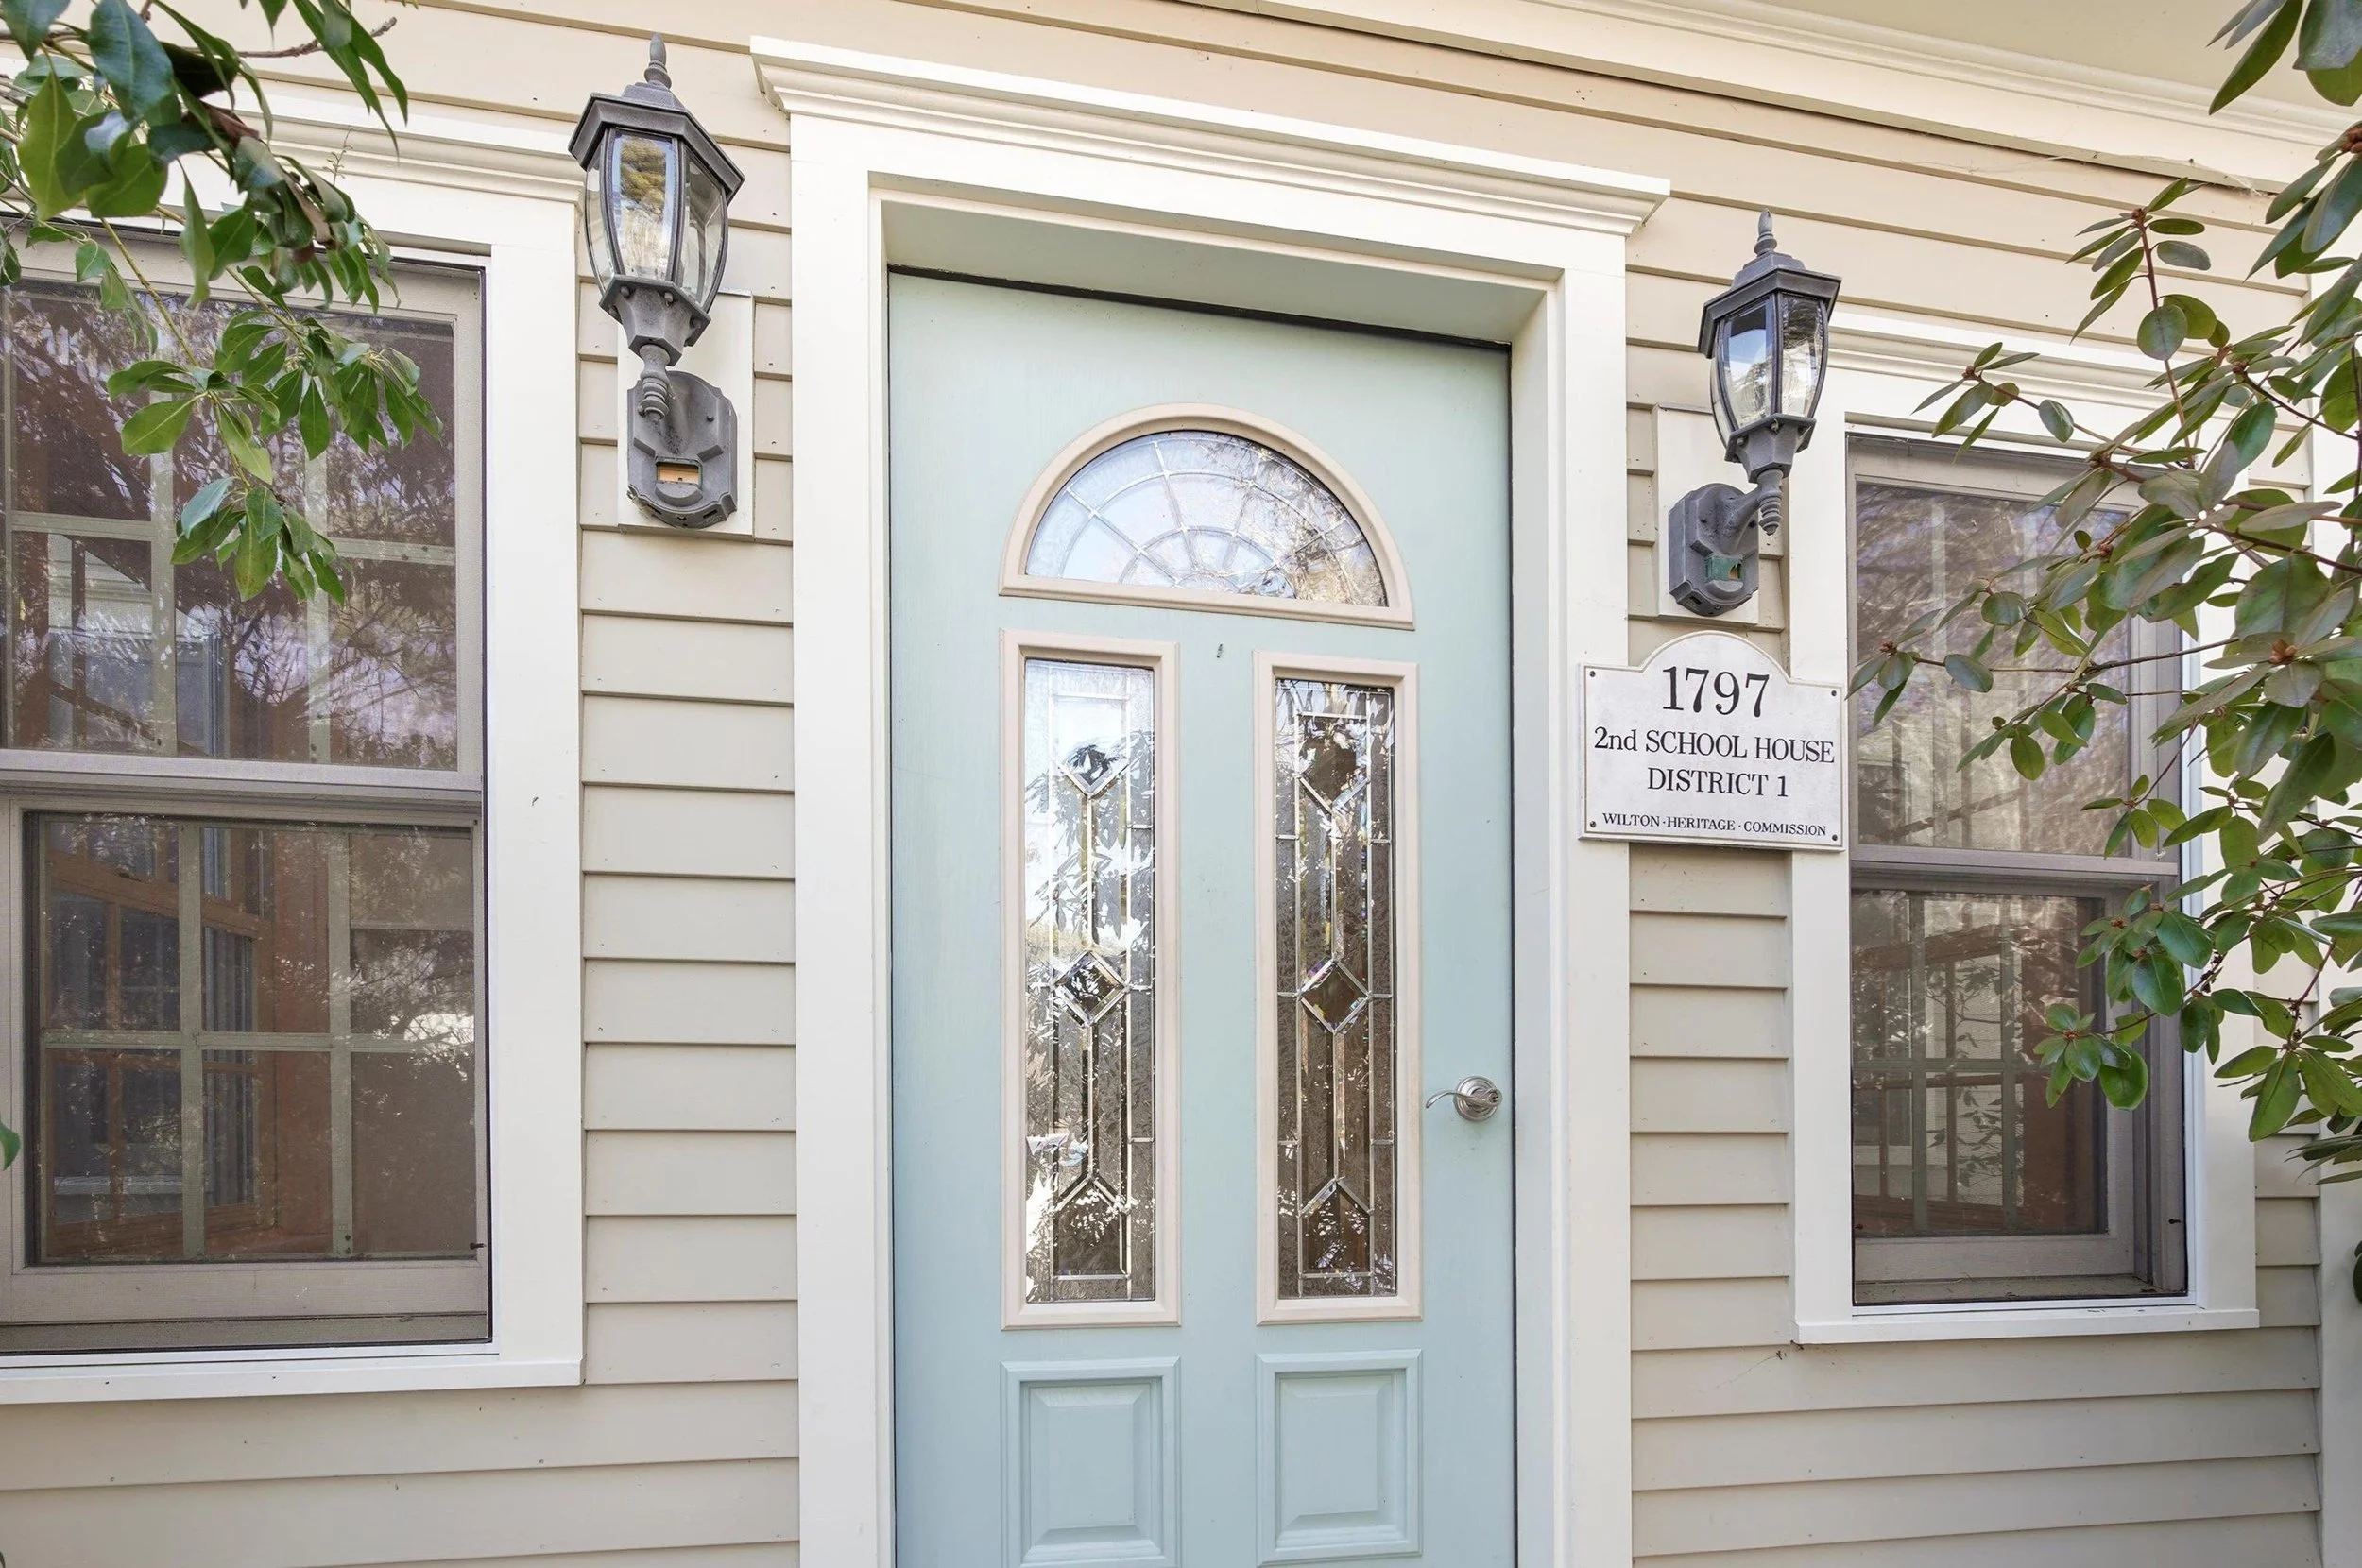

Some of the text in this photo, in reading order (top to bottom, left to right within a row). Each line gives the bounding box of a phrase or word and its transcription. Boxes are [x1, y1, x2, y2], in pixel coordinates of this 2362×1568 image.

[1662, 666, 1770, 718] 1797
[1594, 726, 1835, 764] 2nd SCHOOL HOUSE
[1647, 767, 1789, 797] DISTRICT 1
[1602, 812, 1827, 836] WILTON HERITAGE COMMISSION
